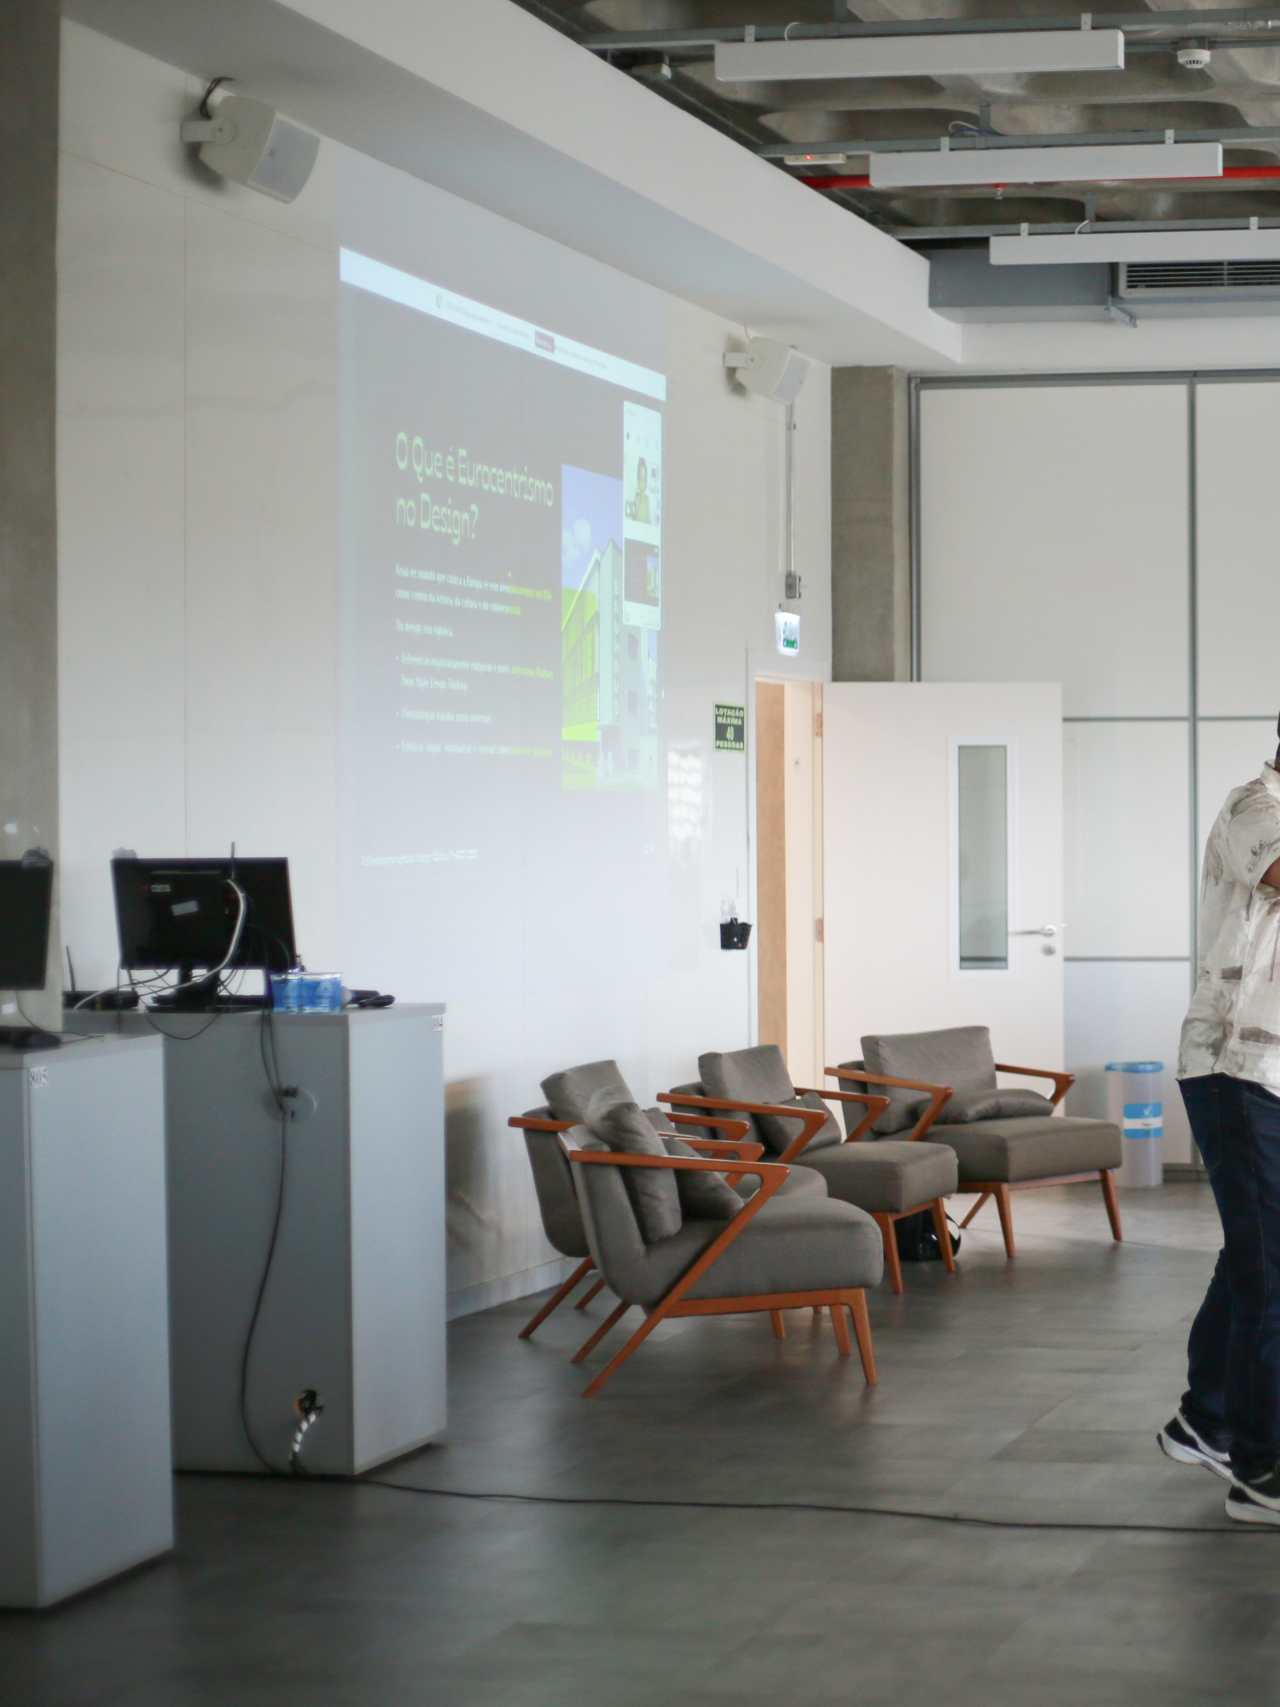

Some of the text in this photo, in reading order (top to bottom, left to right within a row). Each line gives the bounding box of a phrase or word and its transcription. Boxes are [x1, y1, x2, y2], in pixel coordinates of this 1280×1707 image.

[396, 431, 554, 507] O Que é Eurocentrismo
[396, 492, 479, 545] no Design?
[715, 707, 744, 718] LOTAÇÃO
[716, 715, 743, 726] MÁXIMA
[715, 740, 744, 750] PESSOAS
[30, 1068, 47, 1088] 805
